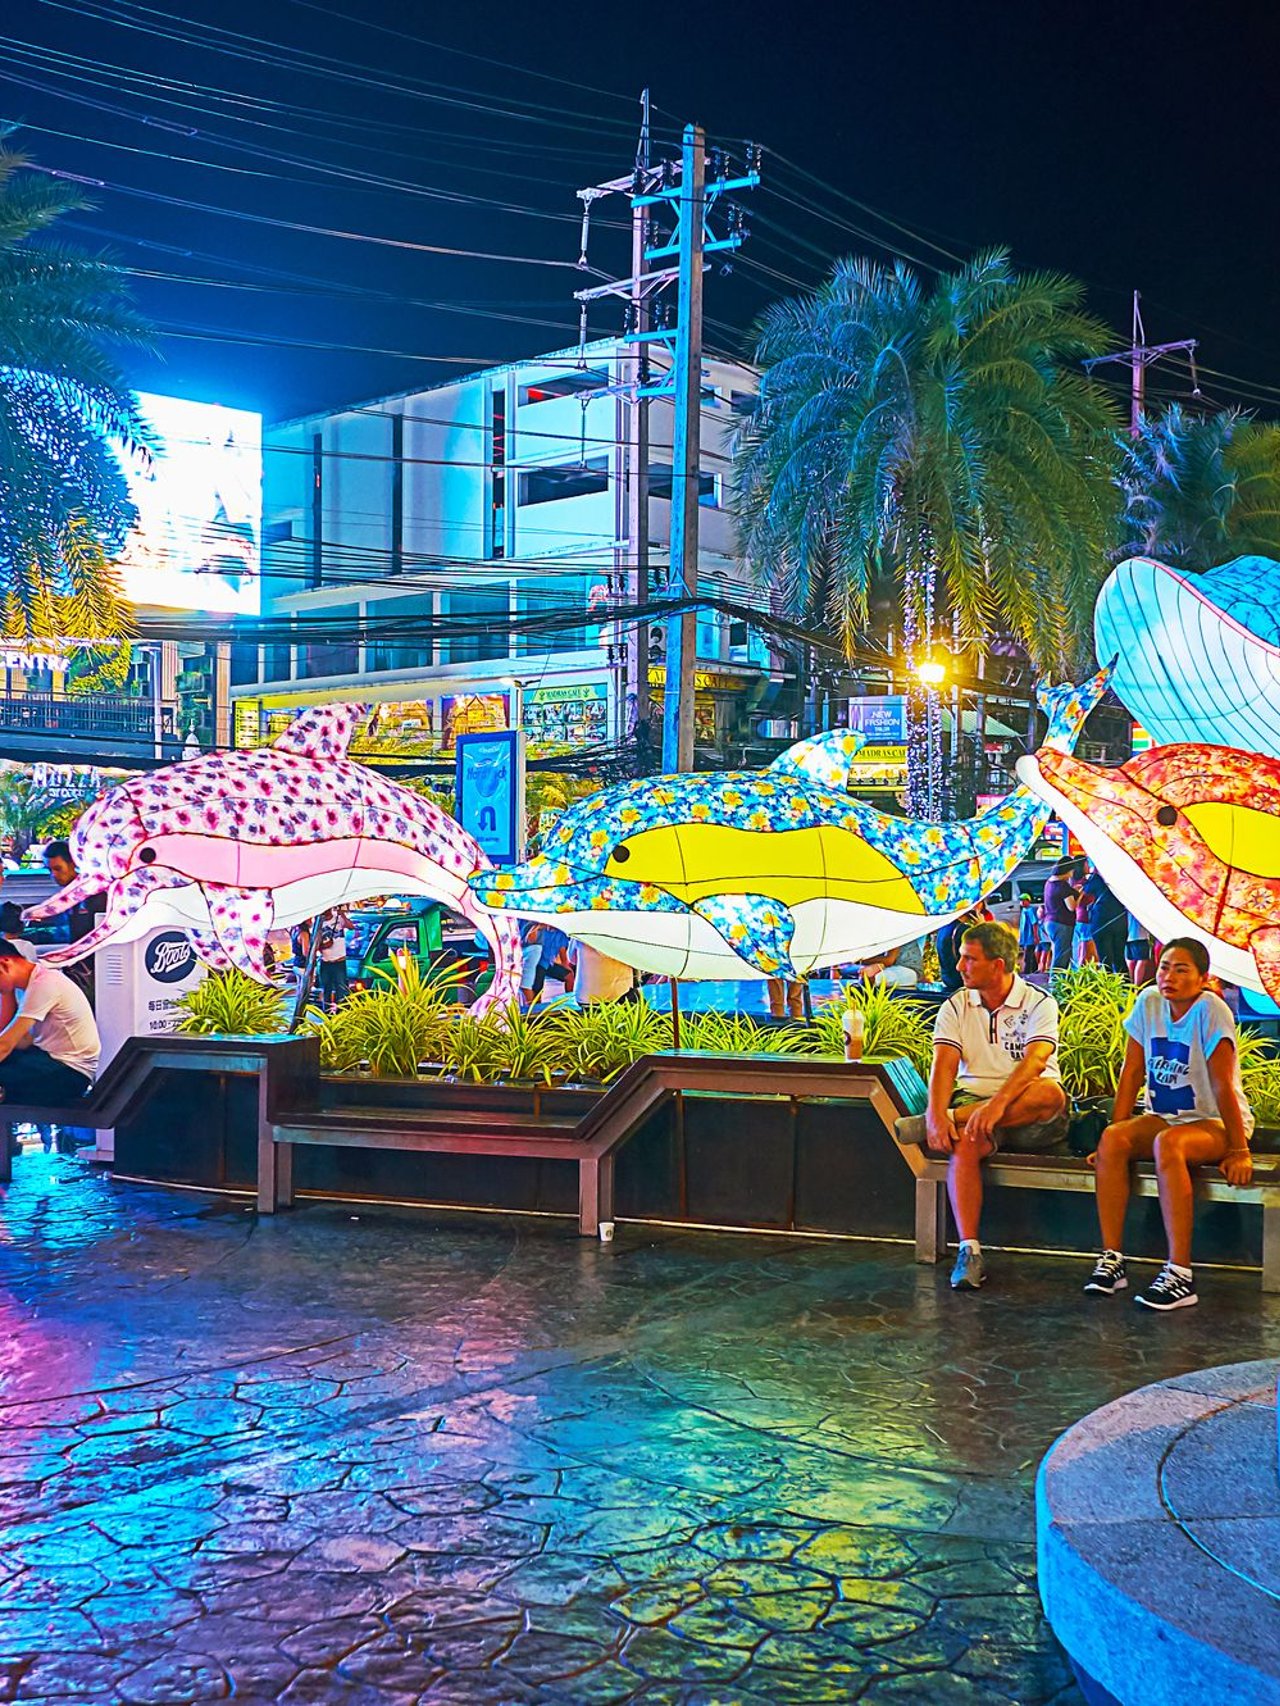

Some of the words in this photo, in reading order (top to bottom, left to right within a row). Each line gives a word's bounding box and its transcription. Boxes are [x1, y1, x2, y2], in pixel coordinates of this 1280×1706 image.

[871, 710, 893, 719] NEW
[864, 718, 900, 726] FASHION
[150, 941, 191, 974] Boots
